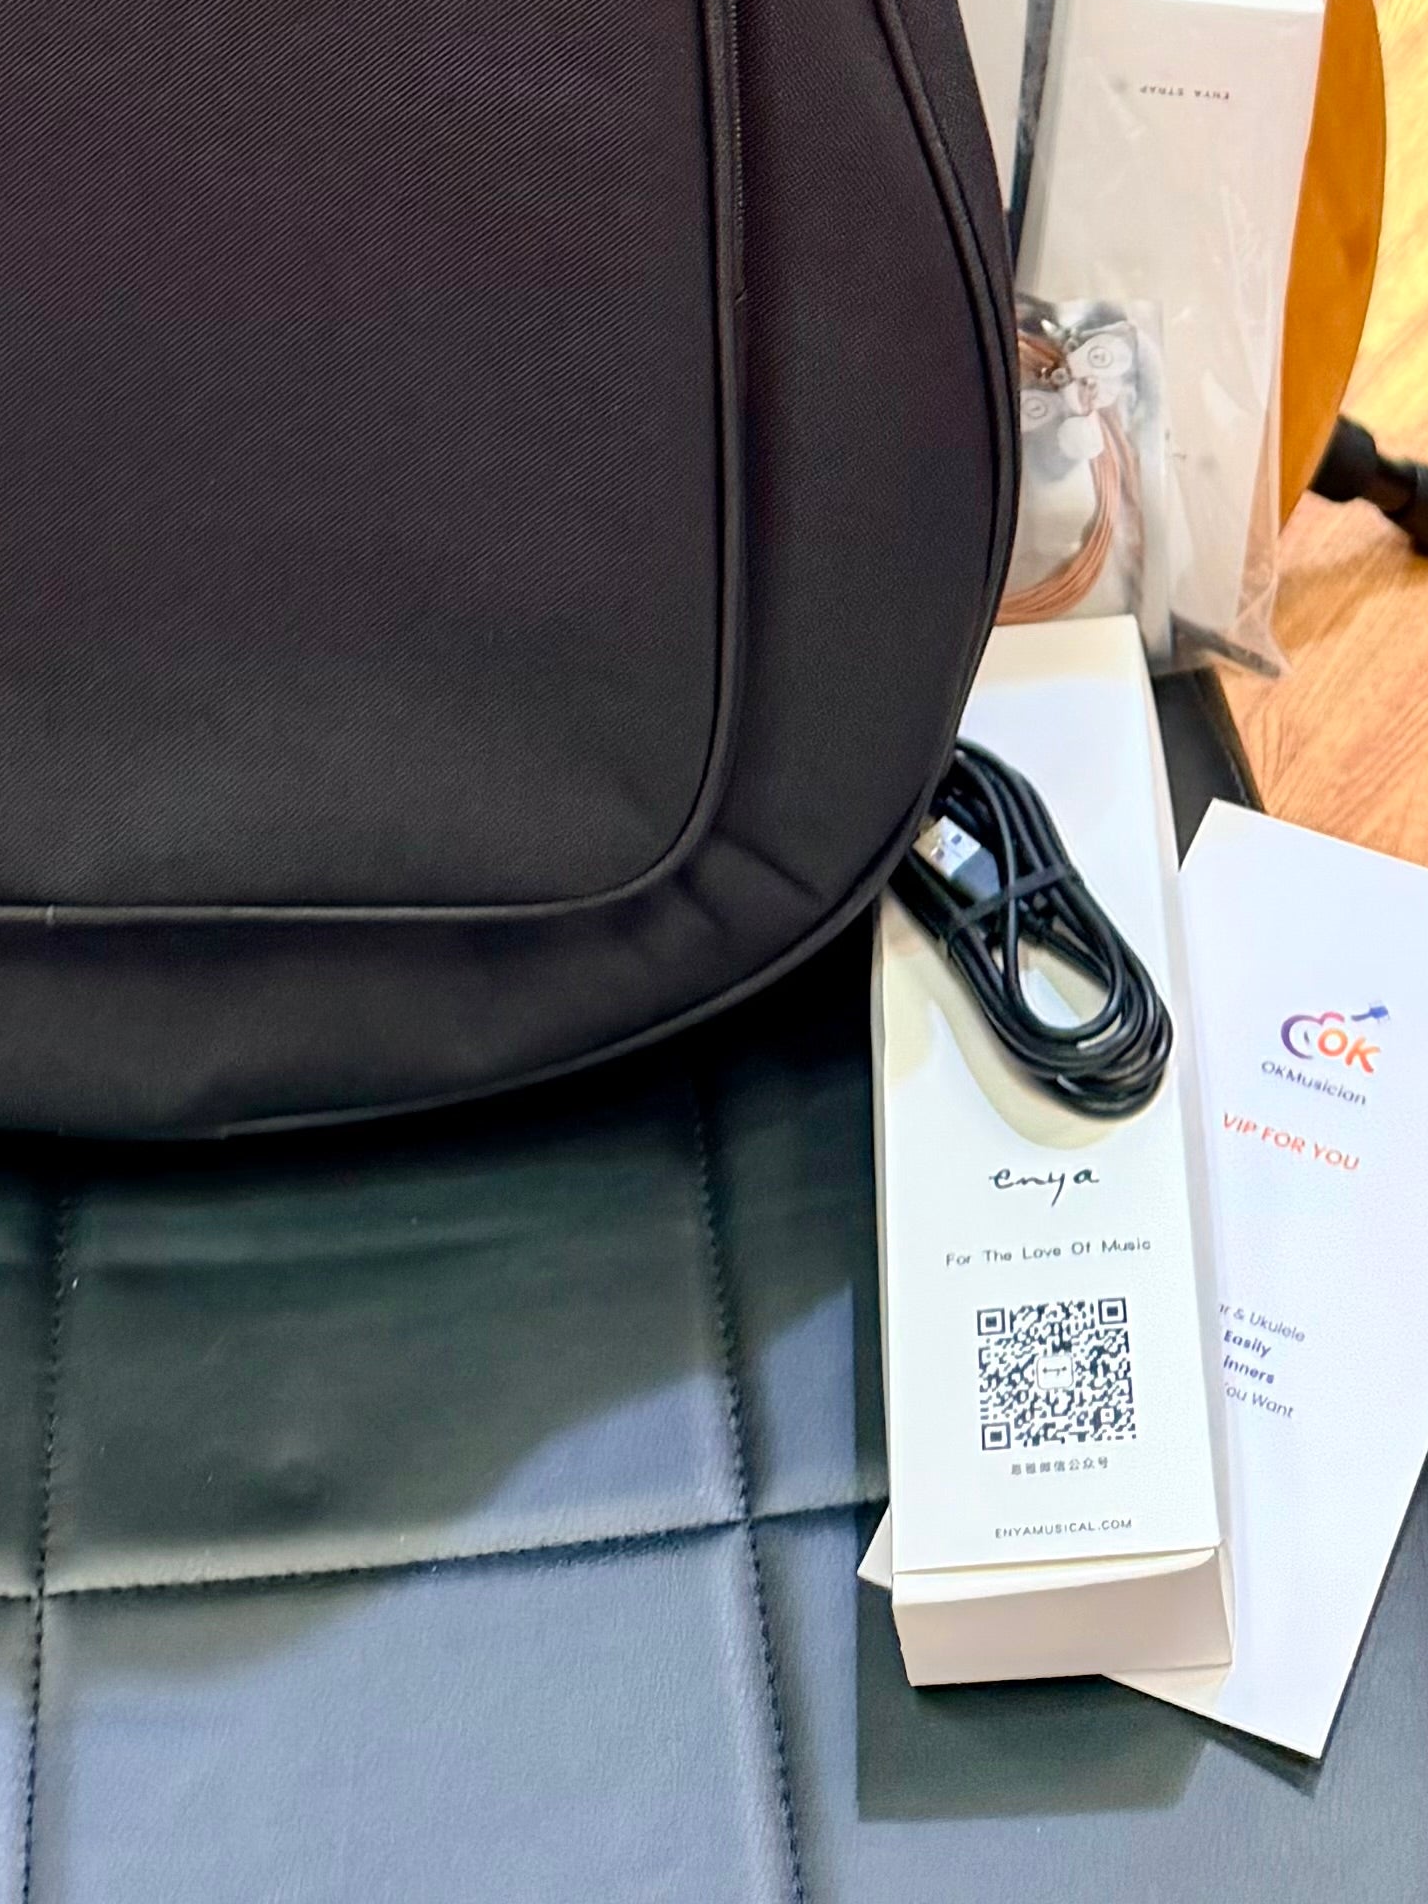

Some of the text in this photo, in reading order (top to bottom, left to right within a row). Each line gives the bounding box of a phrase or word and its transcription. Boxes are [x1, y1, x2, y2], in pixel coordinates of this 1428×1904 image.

[1261, 1060, 1368, 1106] OKMusician
[1224, 1112, 1360, 1171] VIP FOR YOU
[989, 1168, 1099, 1207] enya
[946, 1237, 1151, 1267] For The Love Of Music
[1233, 1307, 1245, 1321] &
[1249, 1311, 1306, 1343] Ukulele
[1224, 1329, 1272, 1359] Easily
[1223, 1354, 1275, 1385] inners
[1225, 1382, 1294, 1419] ou Want
[995, 1518, 1132, 1538] ENYAMUSICAL.COM
